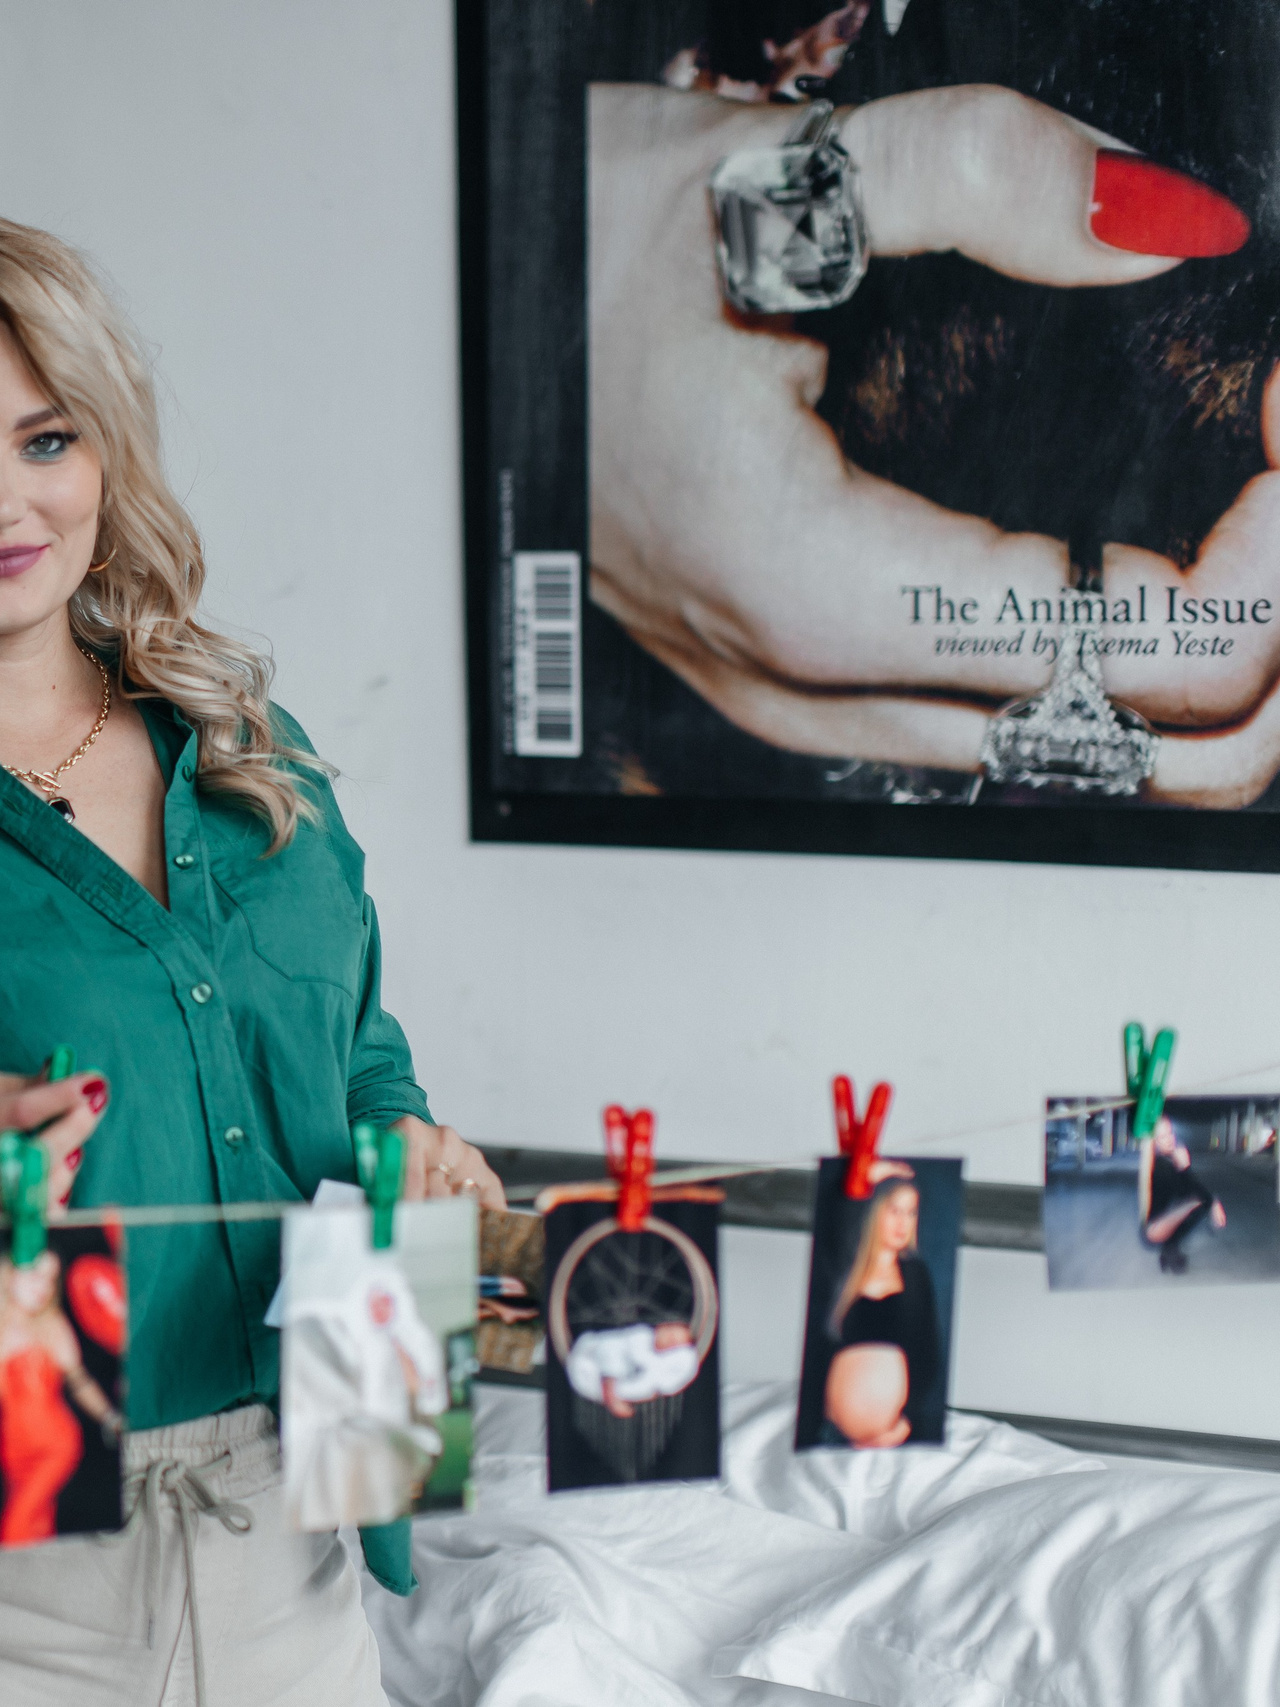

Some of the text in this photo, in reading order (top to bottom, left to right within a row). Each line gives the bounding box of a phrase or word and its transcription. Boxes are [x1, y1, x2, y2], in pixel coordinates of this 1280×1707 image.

[900, 585, 1272, 624] The Animal Issue
[934, 628, 1235, 664] viewed by Txema Yeste
